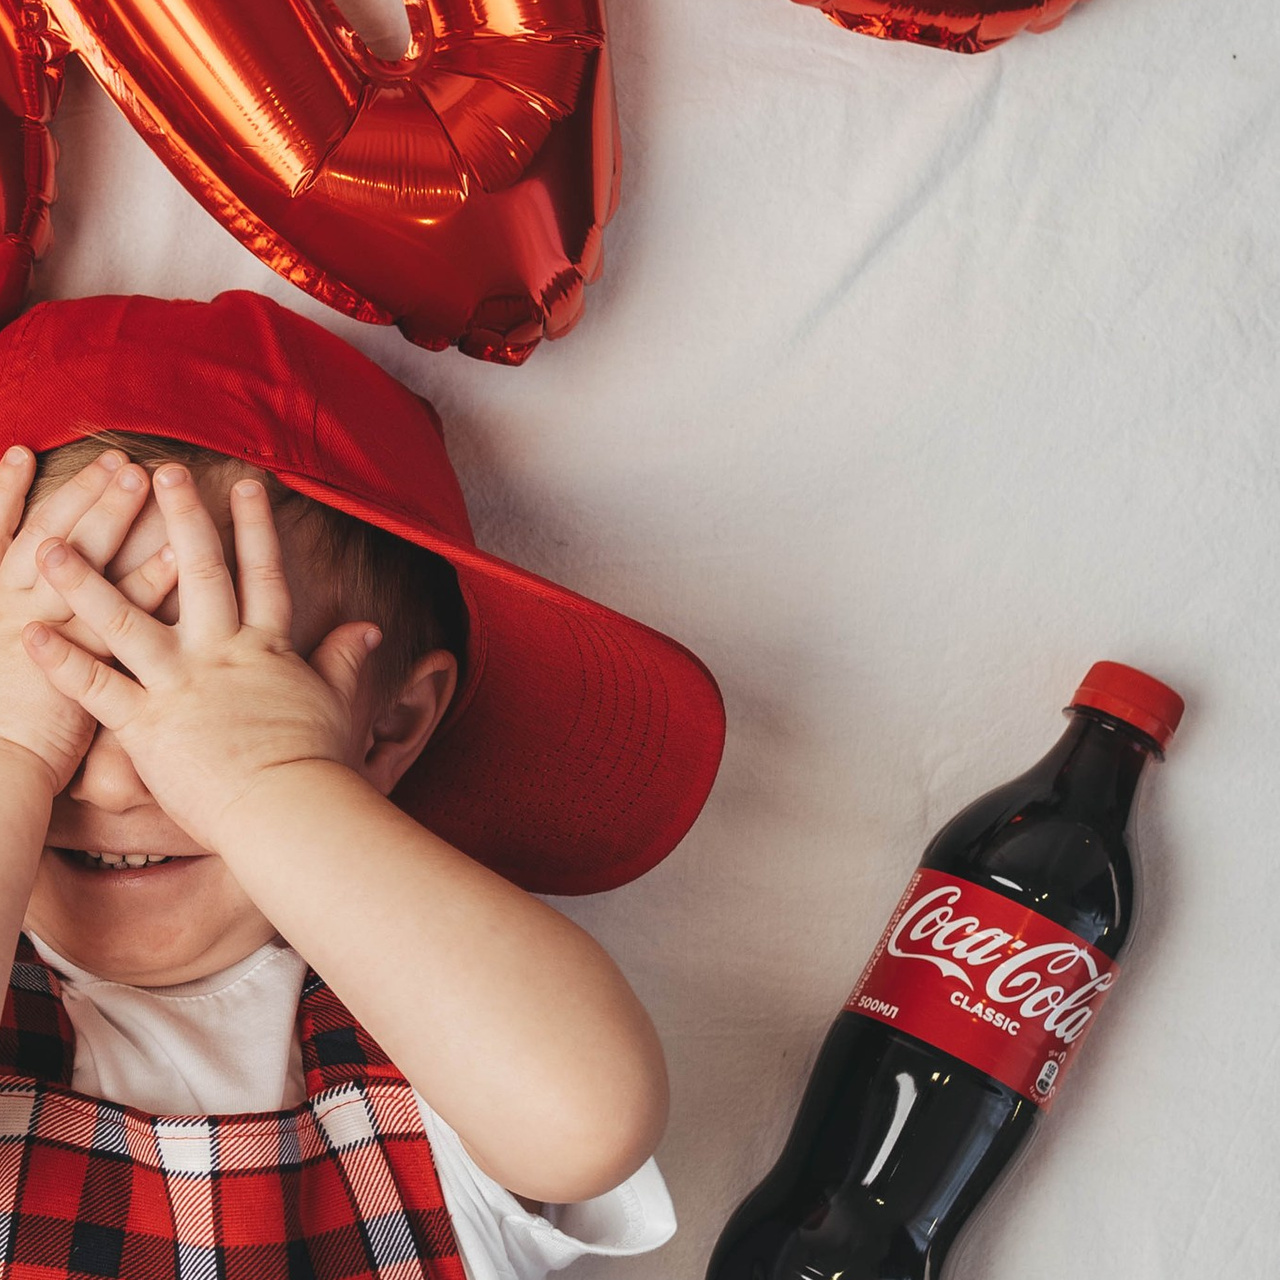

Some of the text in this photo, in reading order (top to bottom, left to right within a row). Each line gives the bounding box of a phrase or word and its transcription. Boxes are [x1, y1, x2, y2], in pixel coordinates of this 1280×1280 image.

[887, 885, 1112, 1044] Coca-Cola
[857, 995, 899, 1019] 500МЛ
[950, 991, 1020, 1036] CLASSIC
